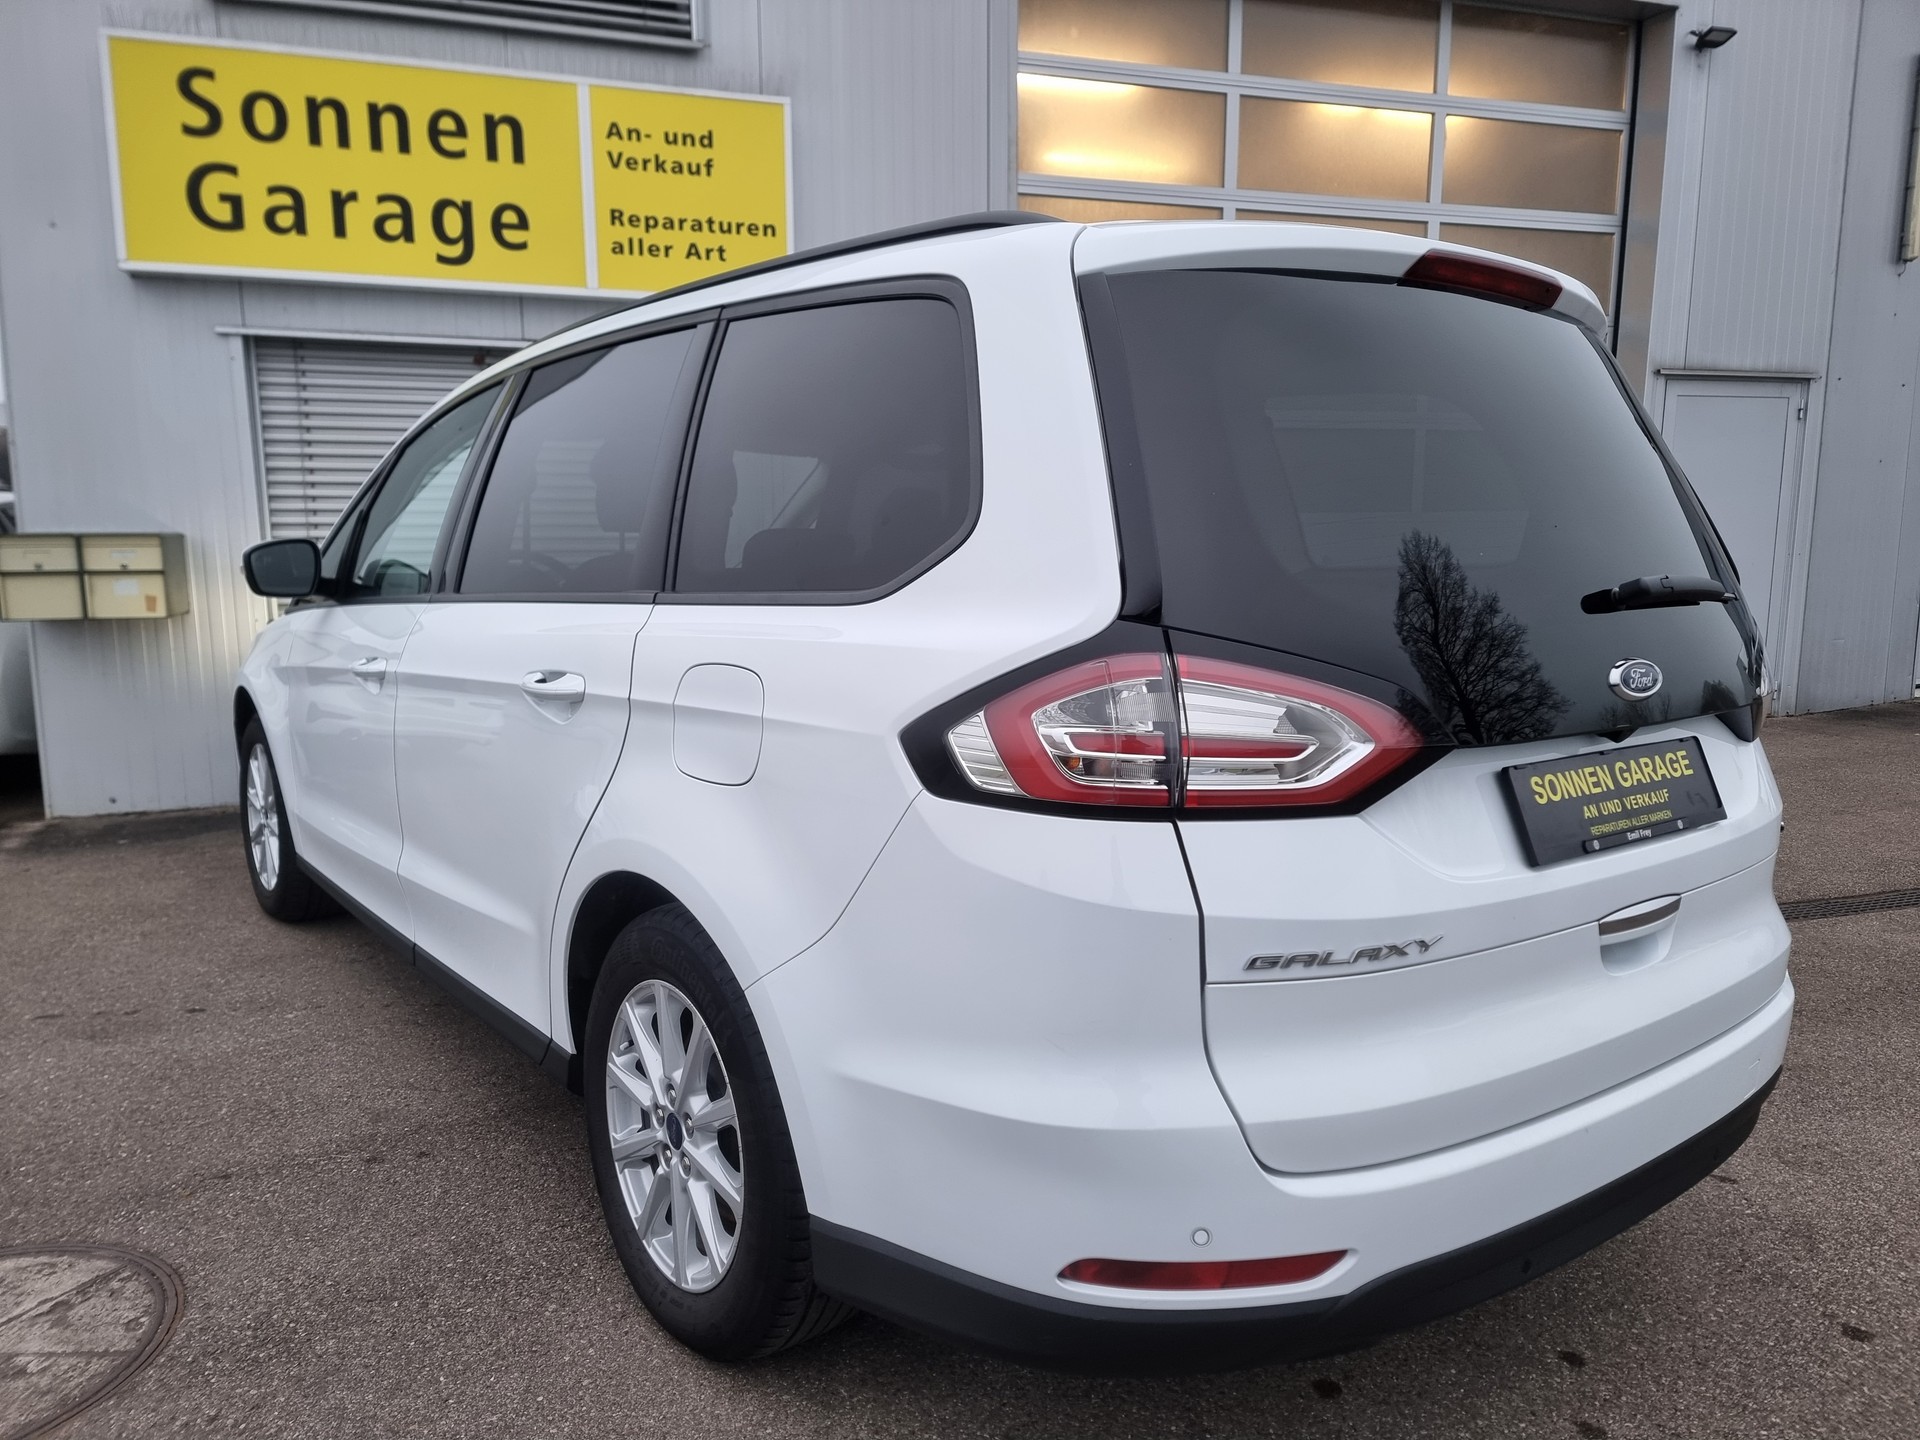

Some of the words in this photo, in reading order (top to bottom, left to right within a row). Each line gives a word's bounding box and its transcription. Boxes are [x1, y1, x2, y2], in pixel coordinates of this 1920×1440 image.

[176, 66, 525, 165] Sonnen
[606, 121, 652, 143] An-
[663, 130, 714, 149] und
[606, 150, 714, 177] Verkauf
[185, 162, 530, 266] Garage
[609, 208, 777, 237] Reparaturen
[610, 237, 673, 258] aller
[685, 242, 727, 262] Art
[1629, 668, 1654, 689] Ford
[1530, 764, 1615, 805] SONNEN
[1615, 750, 1694, 788] GARAGE
[1583, 804, 1599, 819] AN
[1600, 799, 1622, 815] UND
[1622, 789, 1669, 810] VERKAUF
[1590, 820, 1632, 836] REPARATUREN
[1632, 814, 1649, 827] ALLER
[1649, 809, 1673, 822] MARKEN
[1626, 830, 1640, 841] Emil
[1639, 828, 1652, 838] Frey
[1243, 933, 1444, 971] GALAXY
